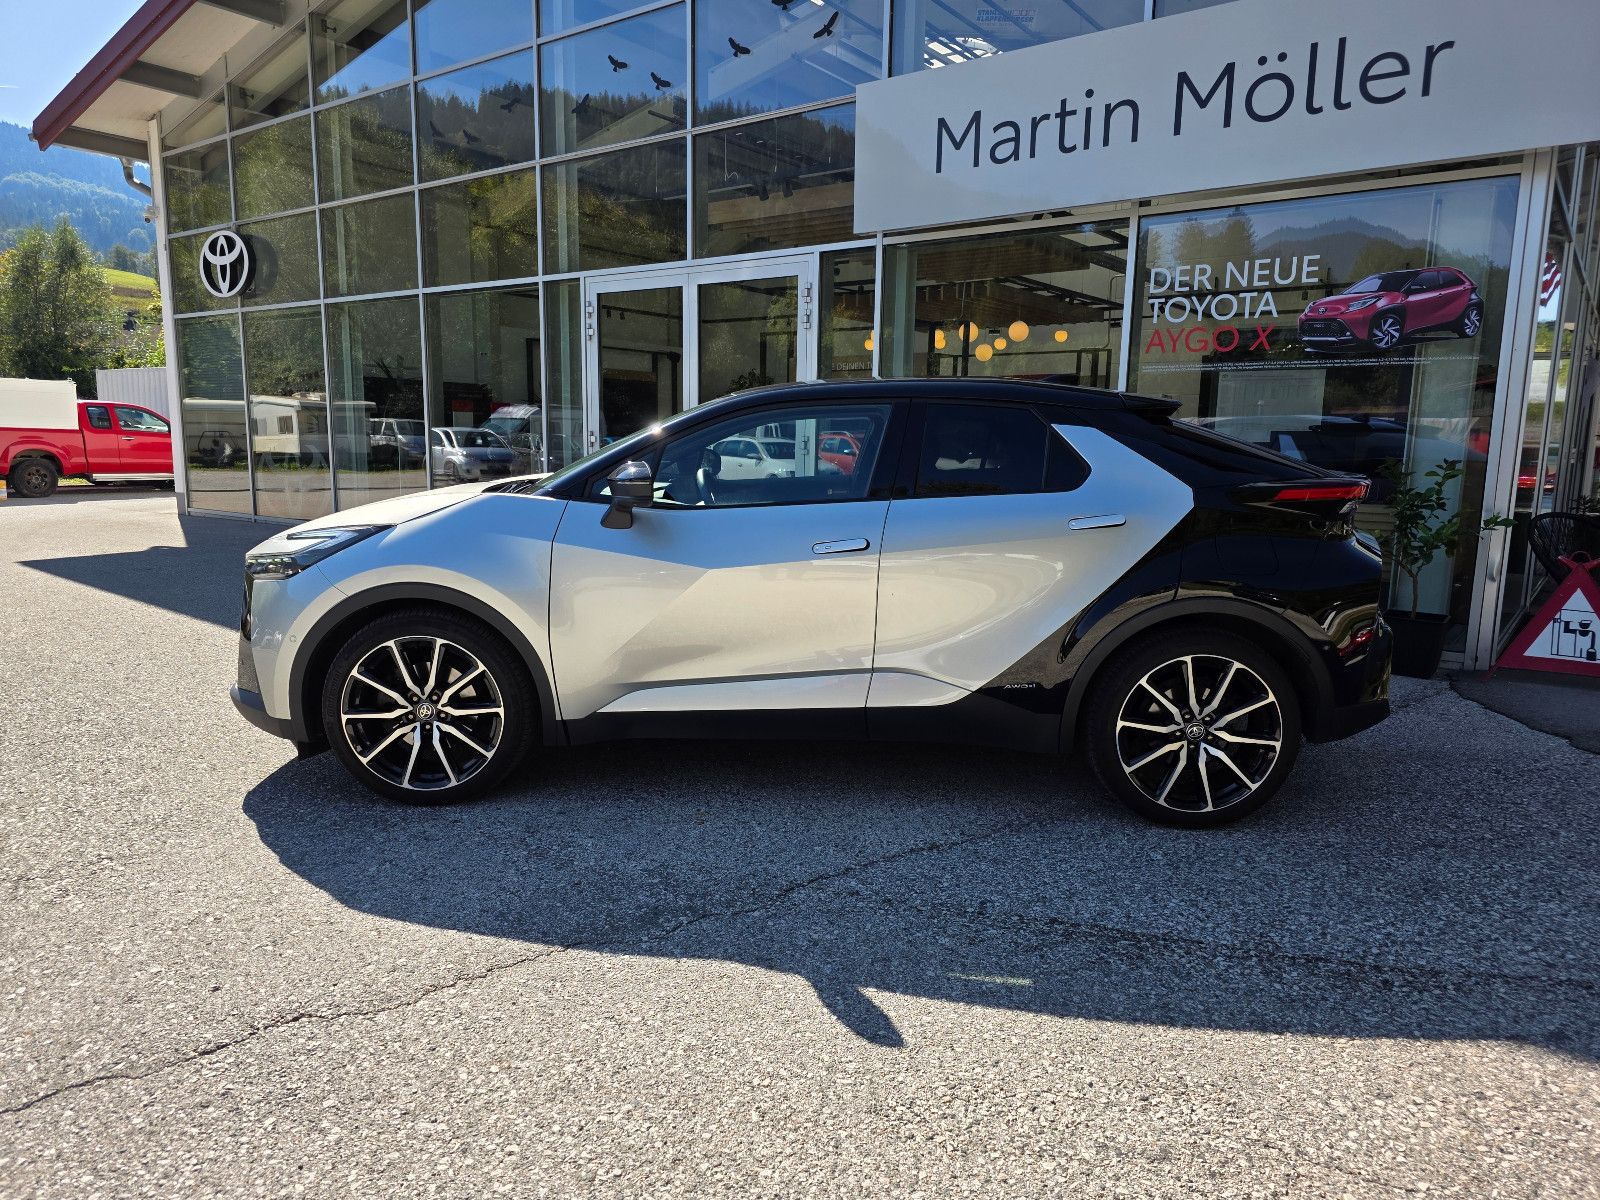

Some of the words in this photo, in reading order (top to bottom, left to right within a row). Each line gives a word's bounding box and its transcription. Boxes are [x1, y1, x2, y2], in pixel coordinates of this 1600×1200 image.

[936, 88, 1140, 174] Martin
[1173, 36, 1455, 137] Möller
[1149, 264, 1212, 294] DER
[1226, 255, 1321, 288] NEUE
[1148, 292, 1278, 324] TOYOTA
[1145, 325, 1240, 354] AYGO
[1250, 324, 1275, 352] X
